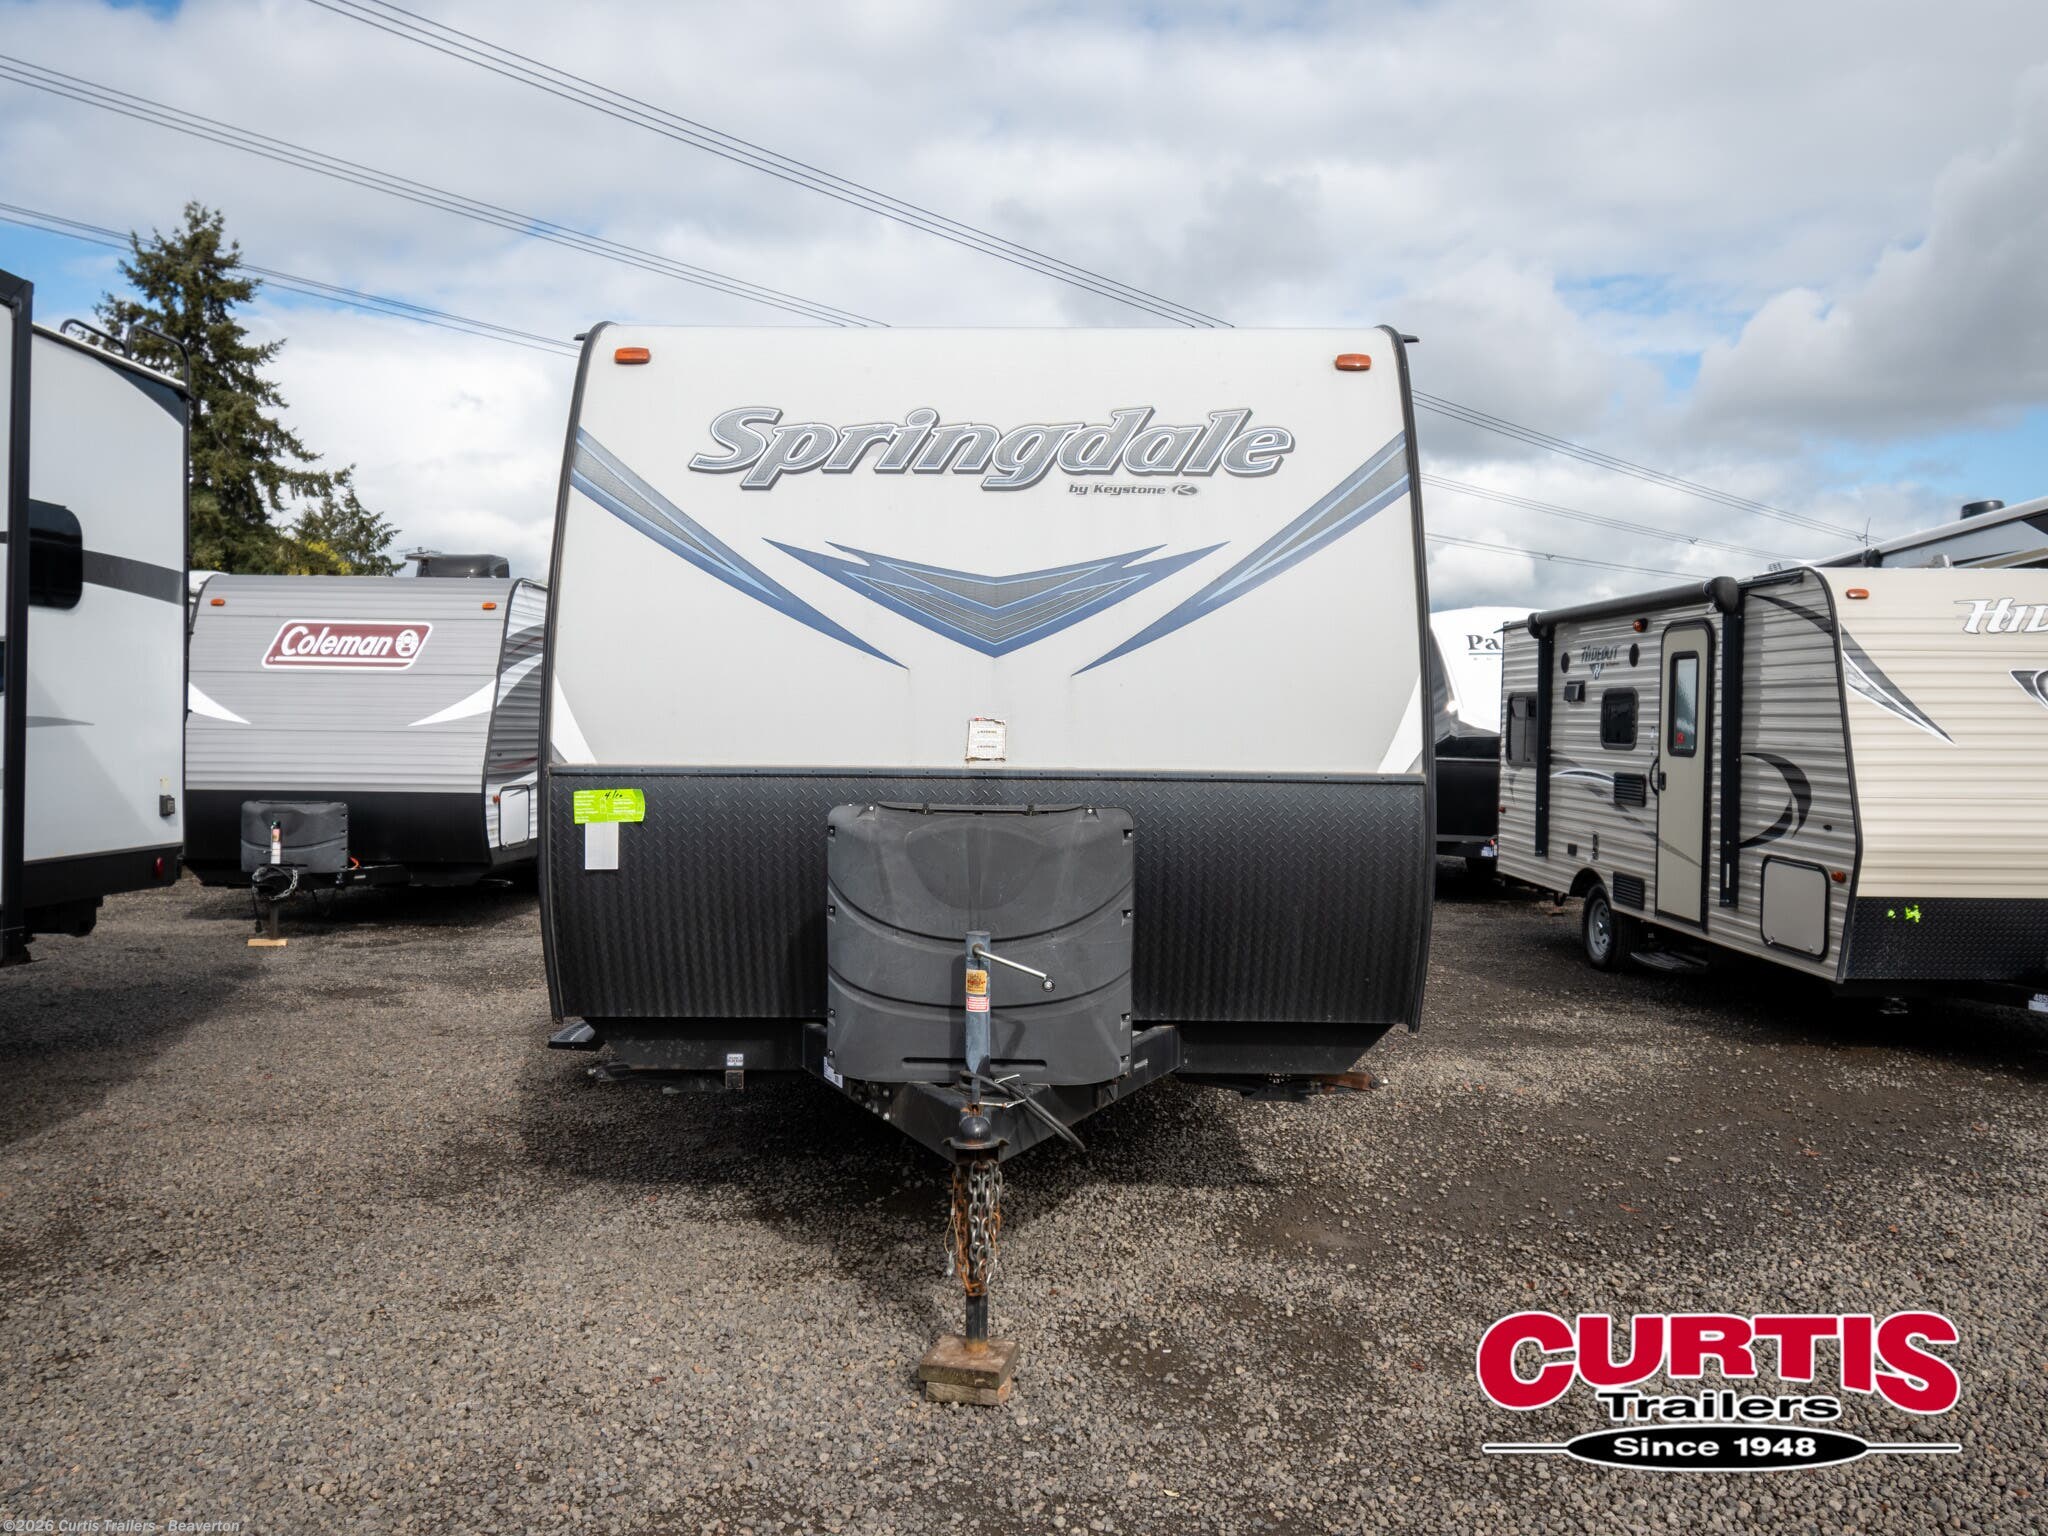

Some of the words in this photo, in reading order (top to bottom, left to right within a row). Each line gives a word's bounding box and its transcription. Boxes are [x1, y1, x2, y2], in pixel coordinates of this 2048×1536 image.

[688, 407, 1296, 491] Springdale
[1069, 484, 1088, 496] by
[1093, 484, 1167, 496] Keystone
[281, 625, 393, 656] Coleman
